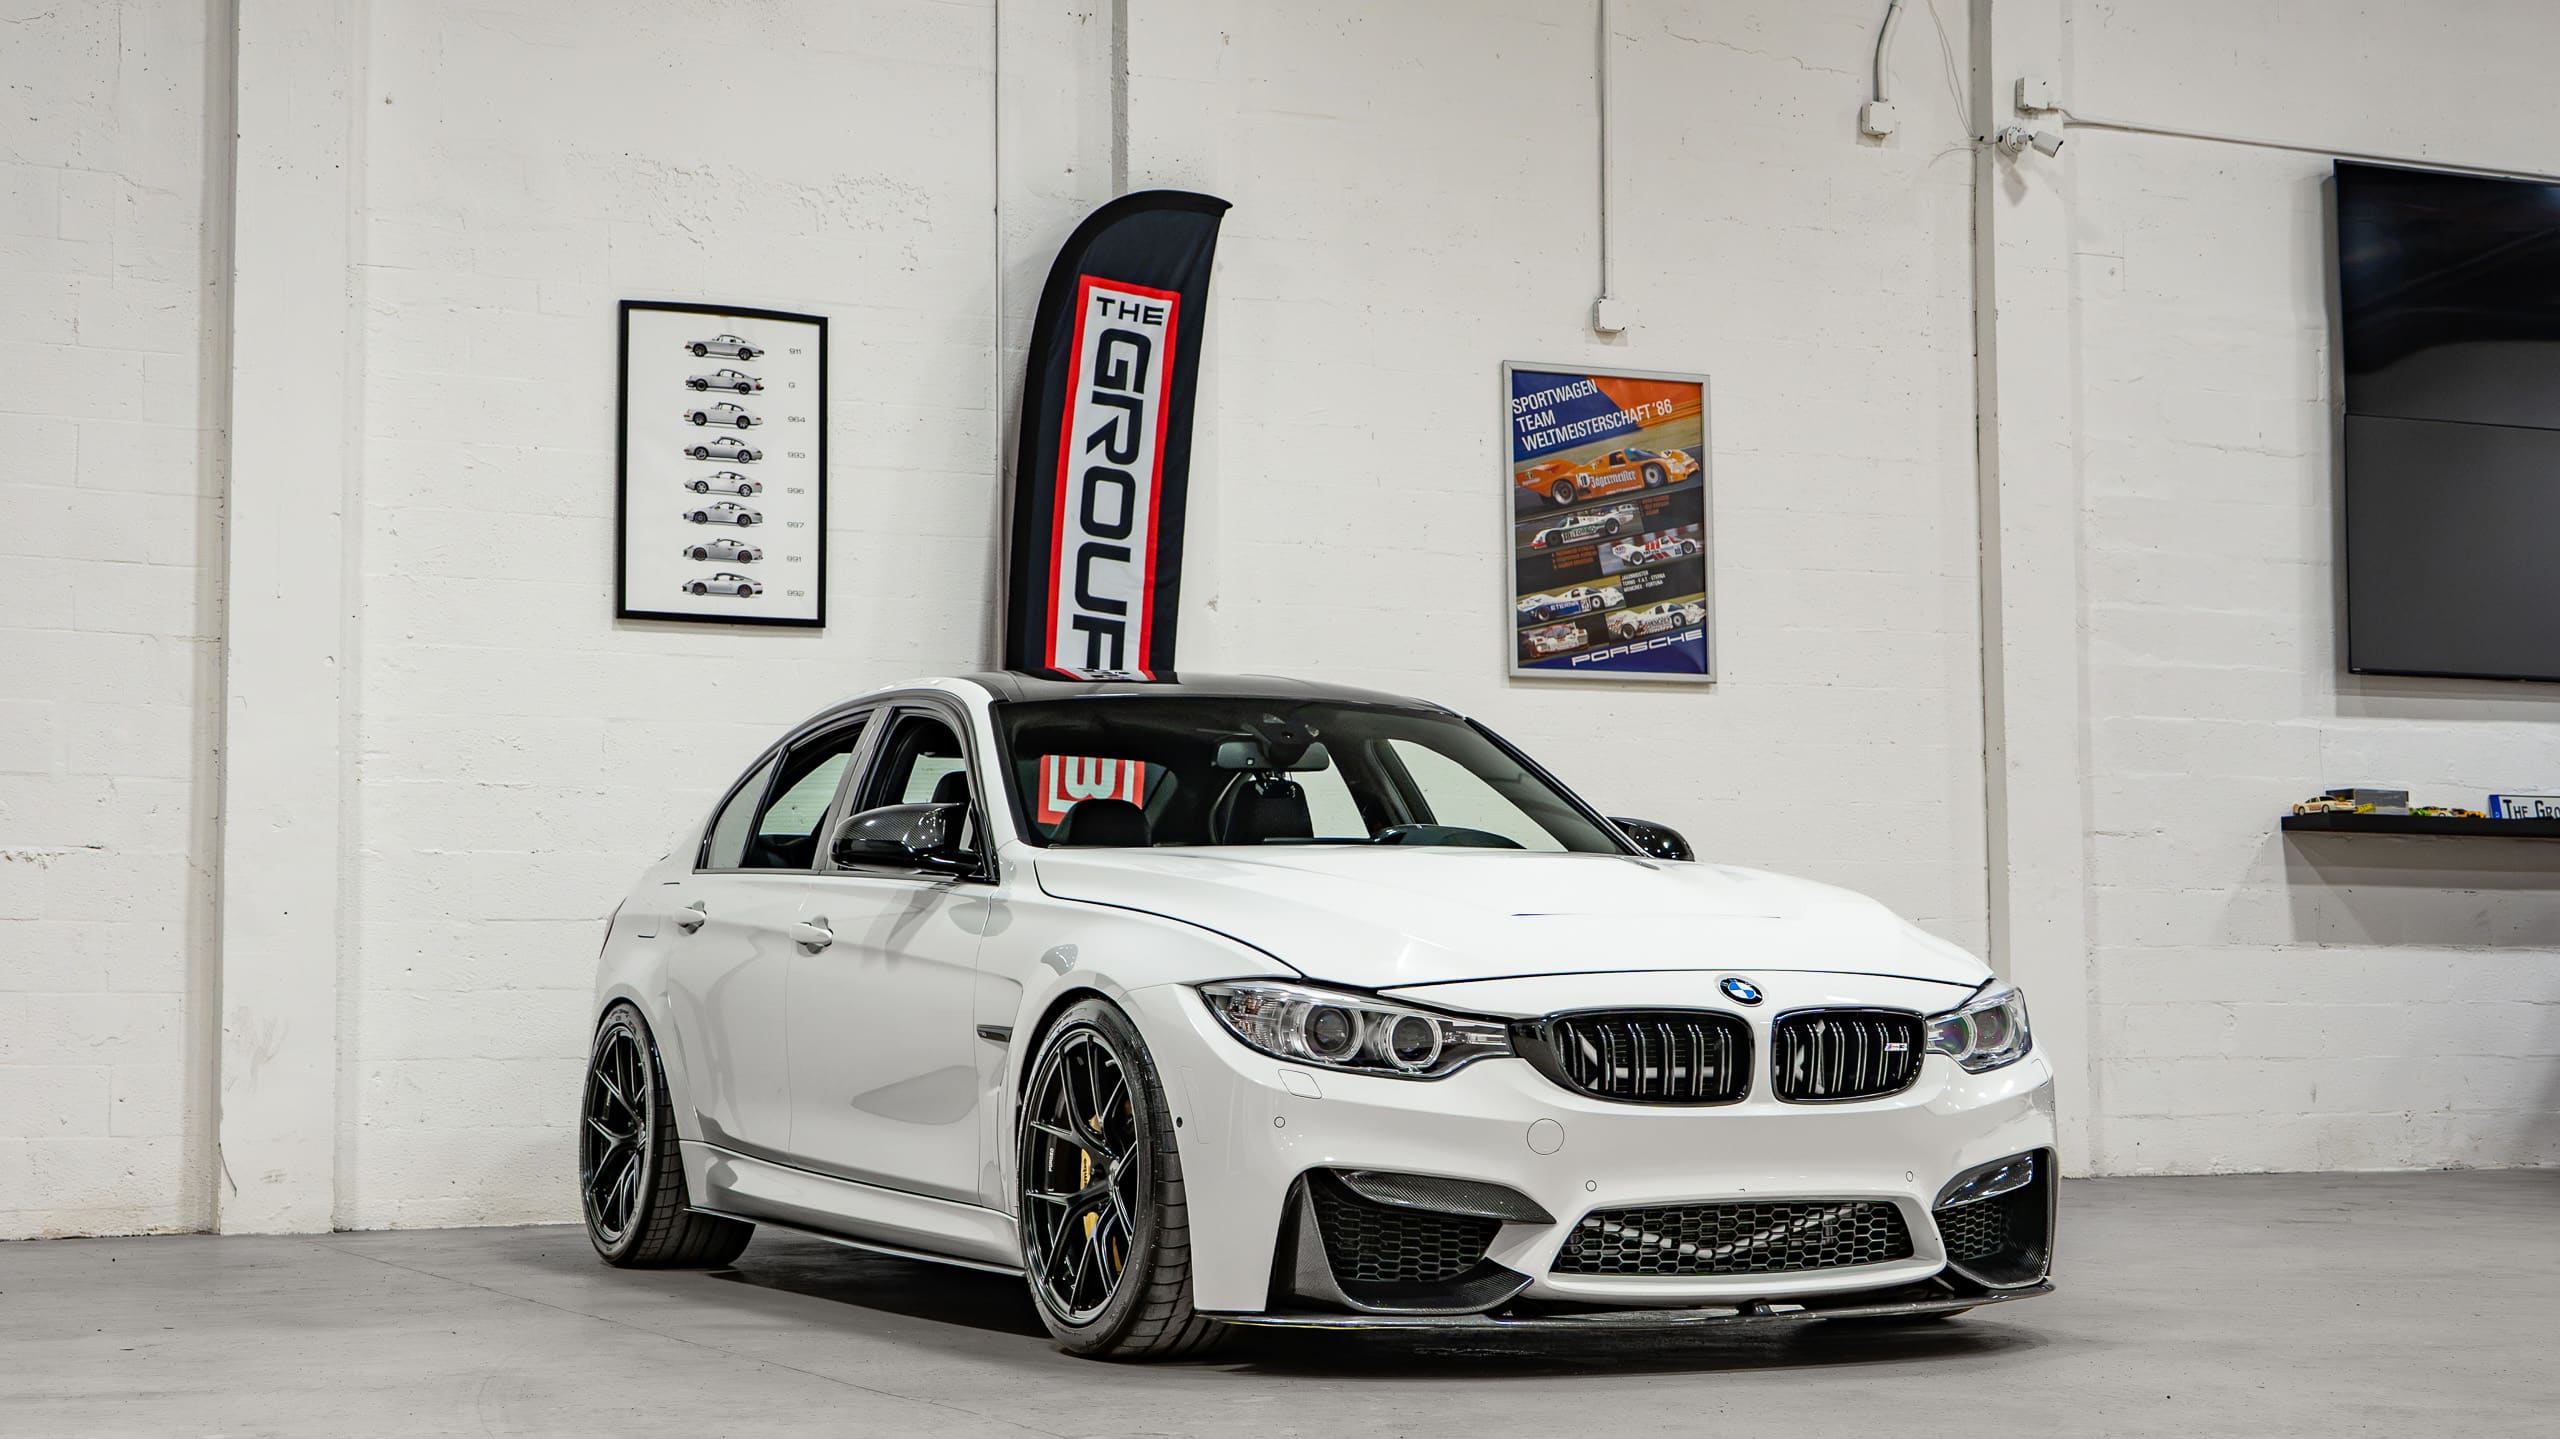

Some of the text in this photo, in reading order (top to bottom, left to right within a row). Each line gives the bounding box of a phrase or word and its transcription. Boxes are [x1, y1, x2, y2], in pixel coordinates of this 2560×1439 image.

[1095, 296, 1164, 326] THE
[1512, 378, 1599, 414] SPORTWAGEN
[787, 415, 806, 423] 964
[1516, 410, 1556, 433] TEAM
[1522, 398, 1673, 451] WELTMEISTERSCHAFT '86
[1571, 629, 1703, 666] PORSCHE
